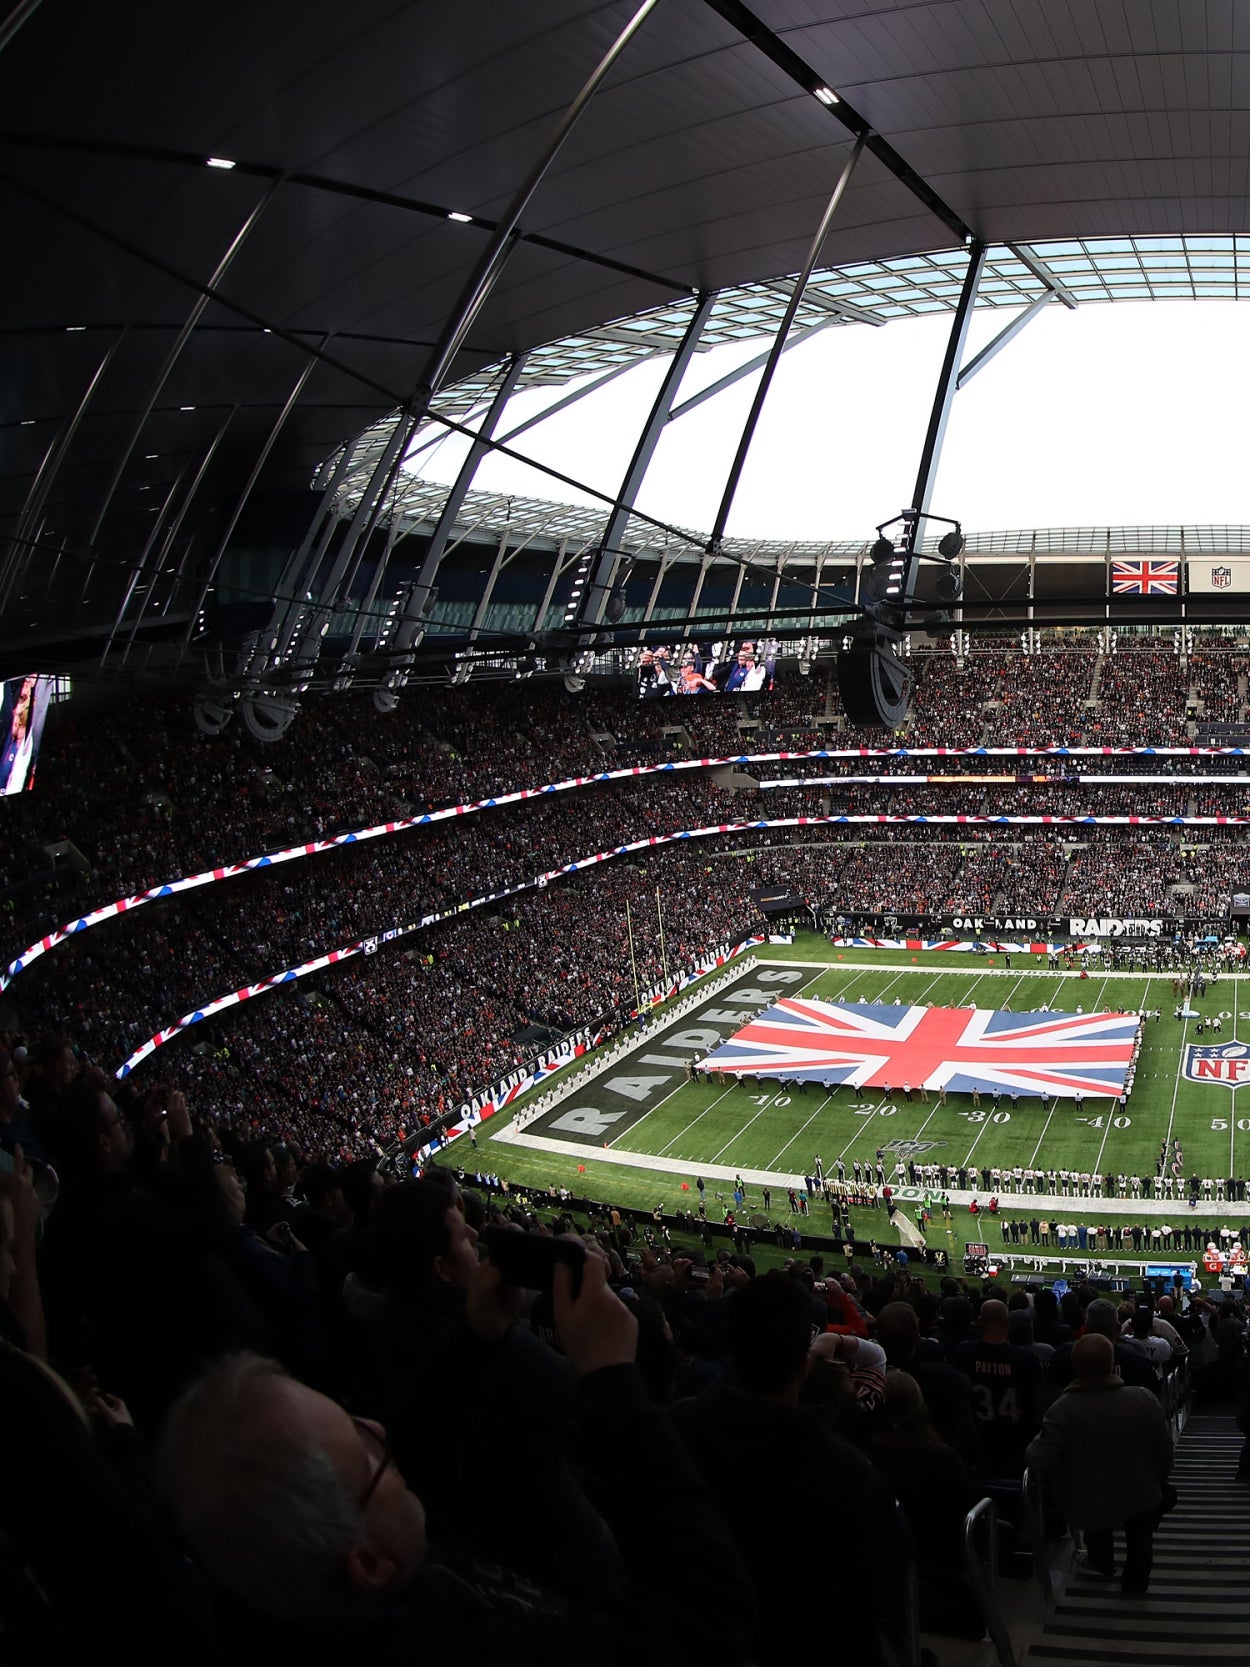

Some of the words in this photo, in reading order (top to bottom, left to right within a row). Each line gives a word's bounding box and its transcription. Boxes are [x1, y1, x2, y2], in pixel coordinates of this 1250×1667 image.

[1213, 575, 1230, 586] NFL
[694, 942, 730, 970] RAIDERS
[548, 968, 803, 1137] RAIDERS
[460, 1069, 527, 1120] OAKLAND
[754, 1094, 791, 1108] 10
[854, 1103, 897, 1117] 20
[967, 1111, 1011, 1124] 30
[1087, 1116, 1131, 1128] 40
[975, 1360, 1011, 1376] PAYTON
[970, 1384, 1021, 1424] 34
